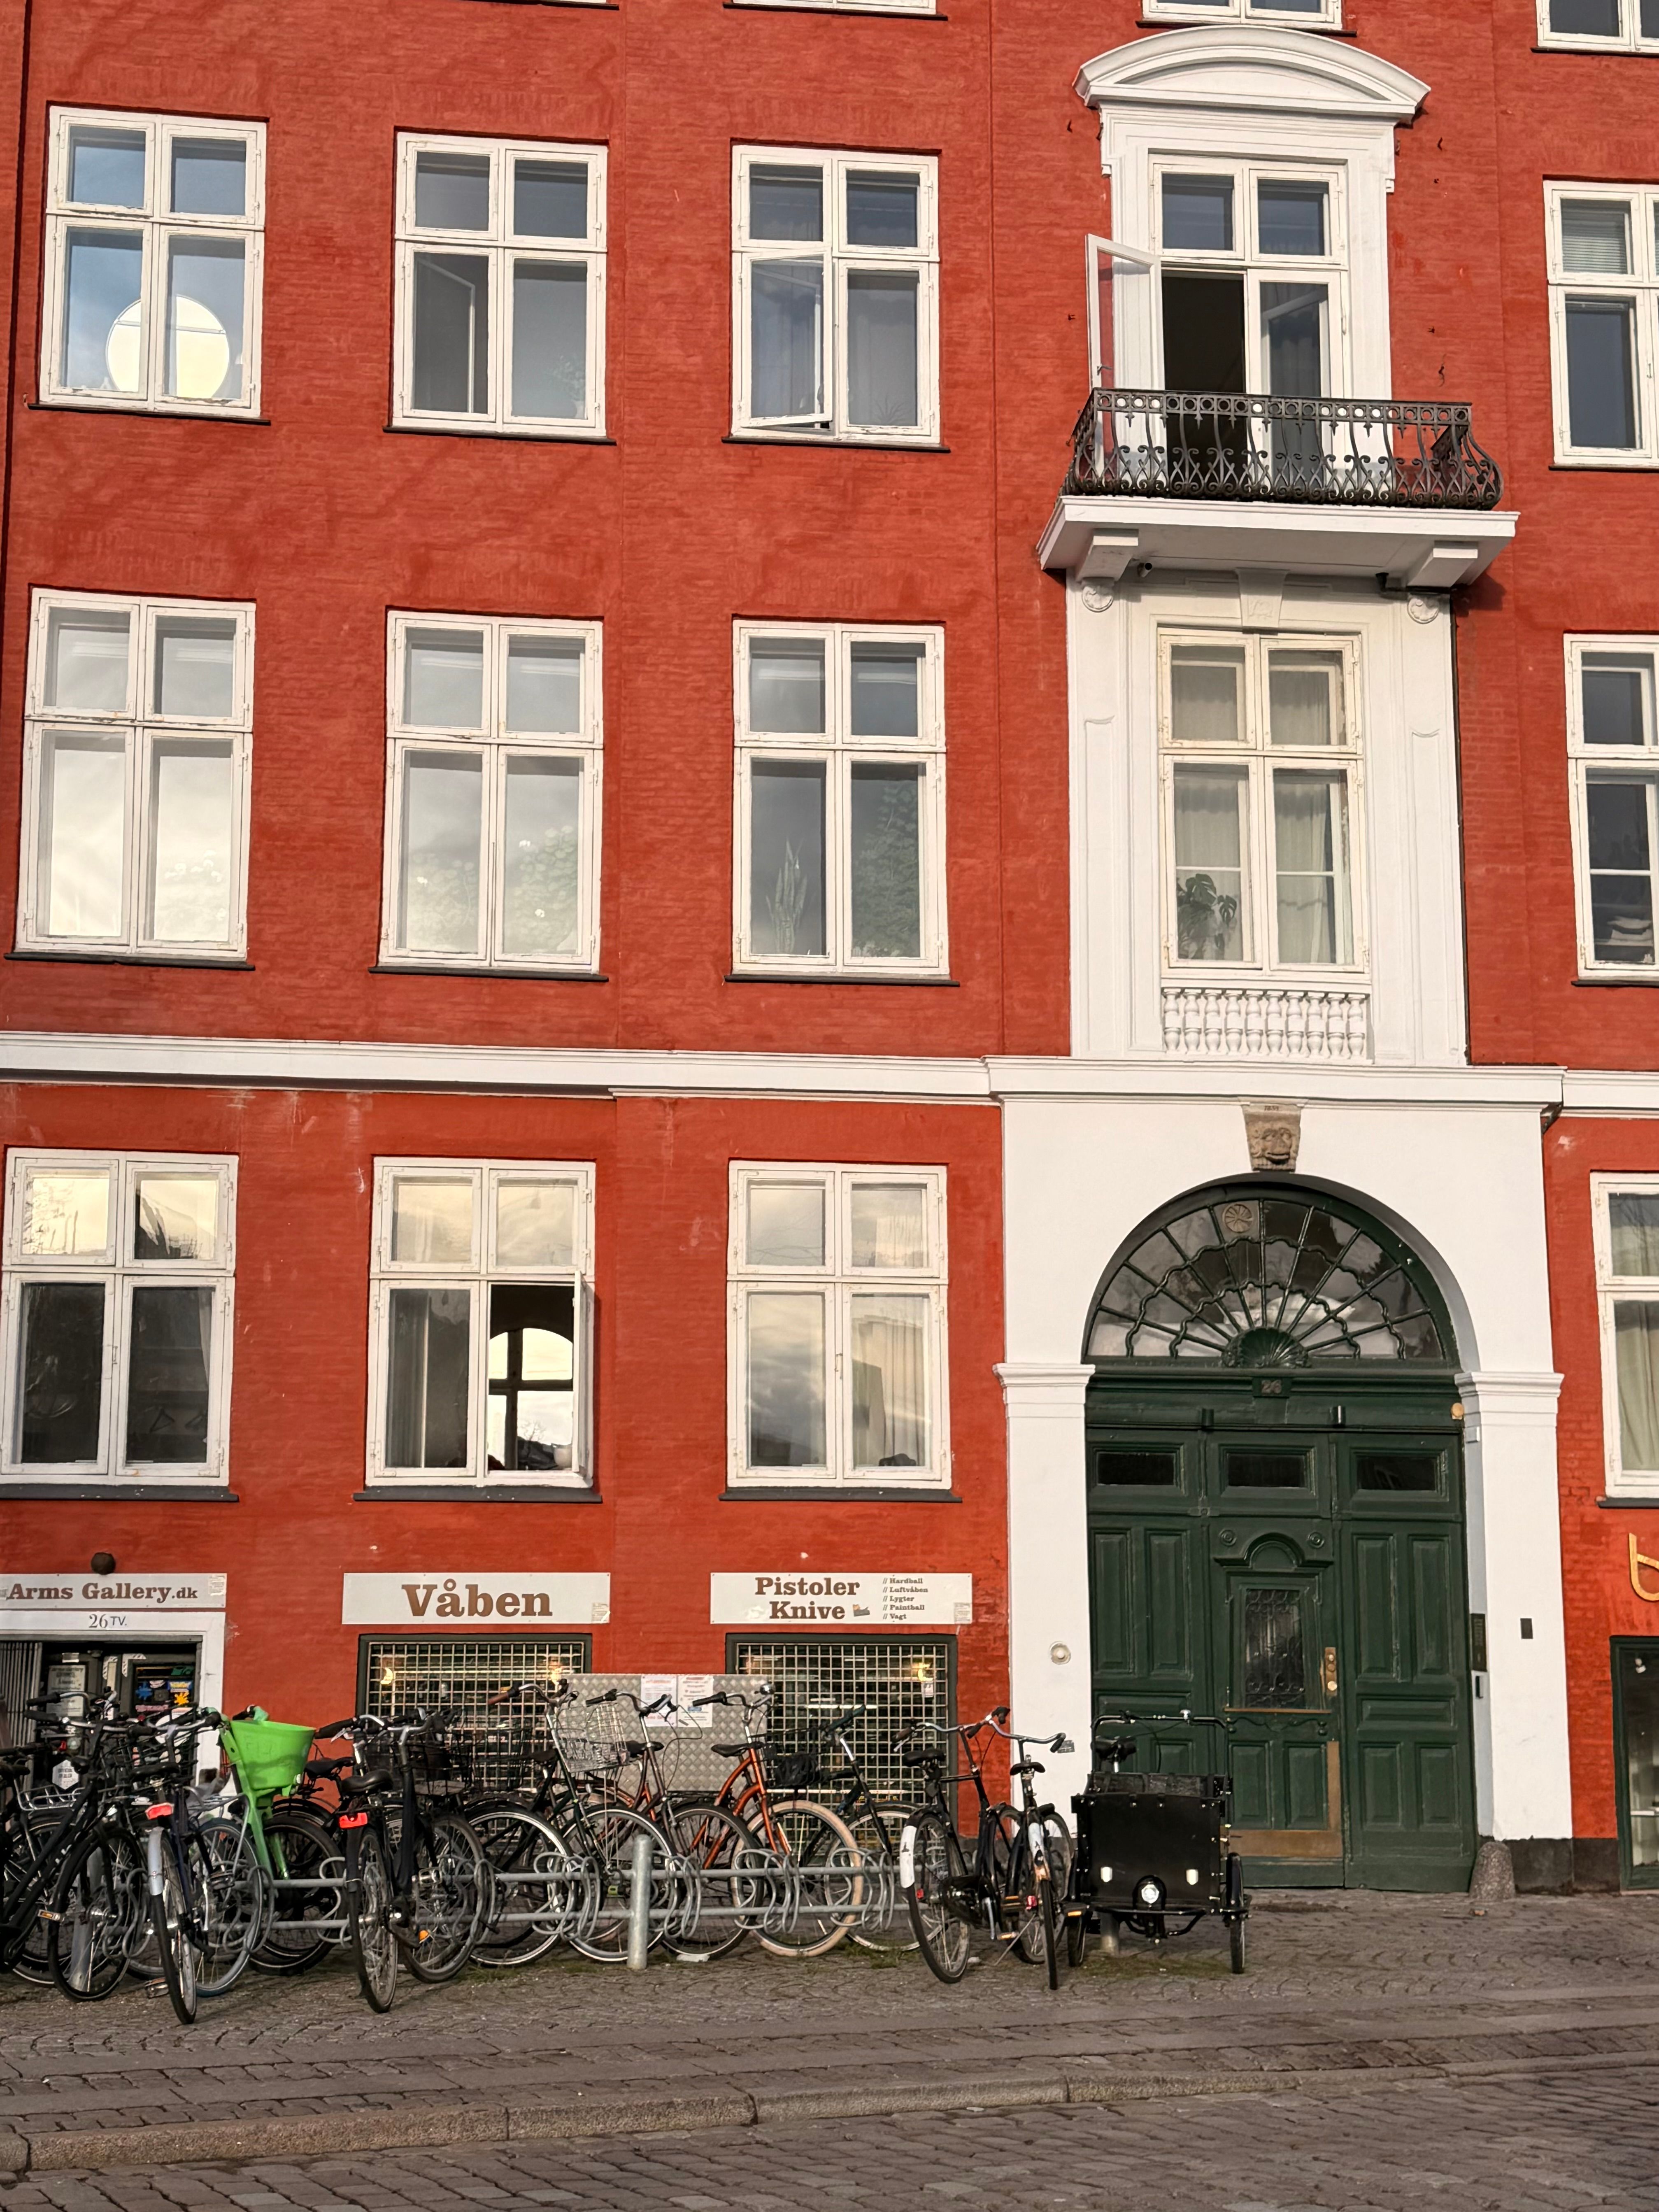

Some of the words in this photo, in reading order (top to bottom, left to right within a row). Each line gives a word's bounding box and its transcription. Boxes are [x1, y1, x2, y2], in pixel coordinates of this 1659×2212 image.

[1261, 1379, 1282, 1394] 26
[6, 1583, 73, 1600] Arms
[82, 1583, 198, 1603] Gallery.dk
[755, 1577, 860, 1595] Pistoler
[401, 1579, 553, 1617] Våben
[769, 1601, 845, 1620] Knive
[89, 1614, 108, 1628] 26
